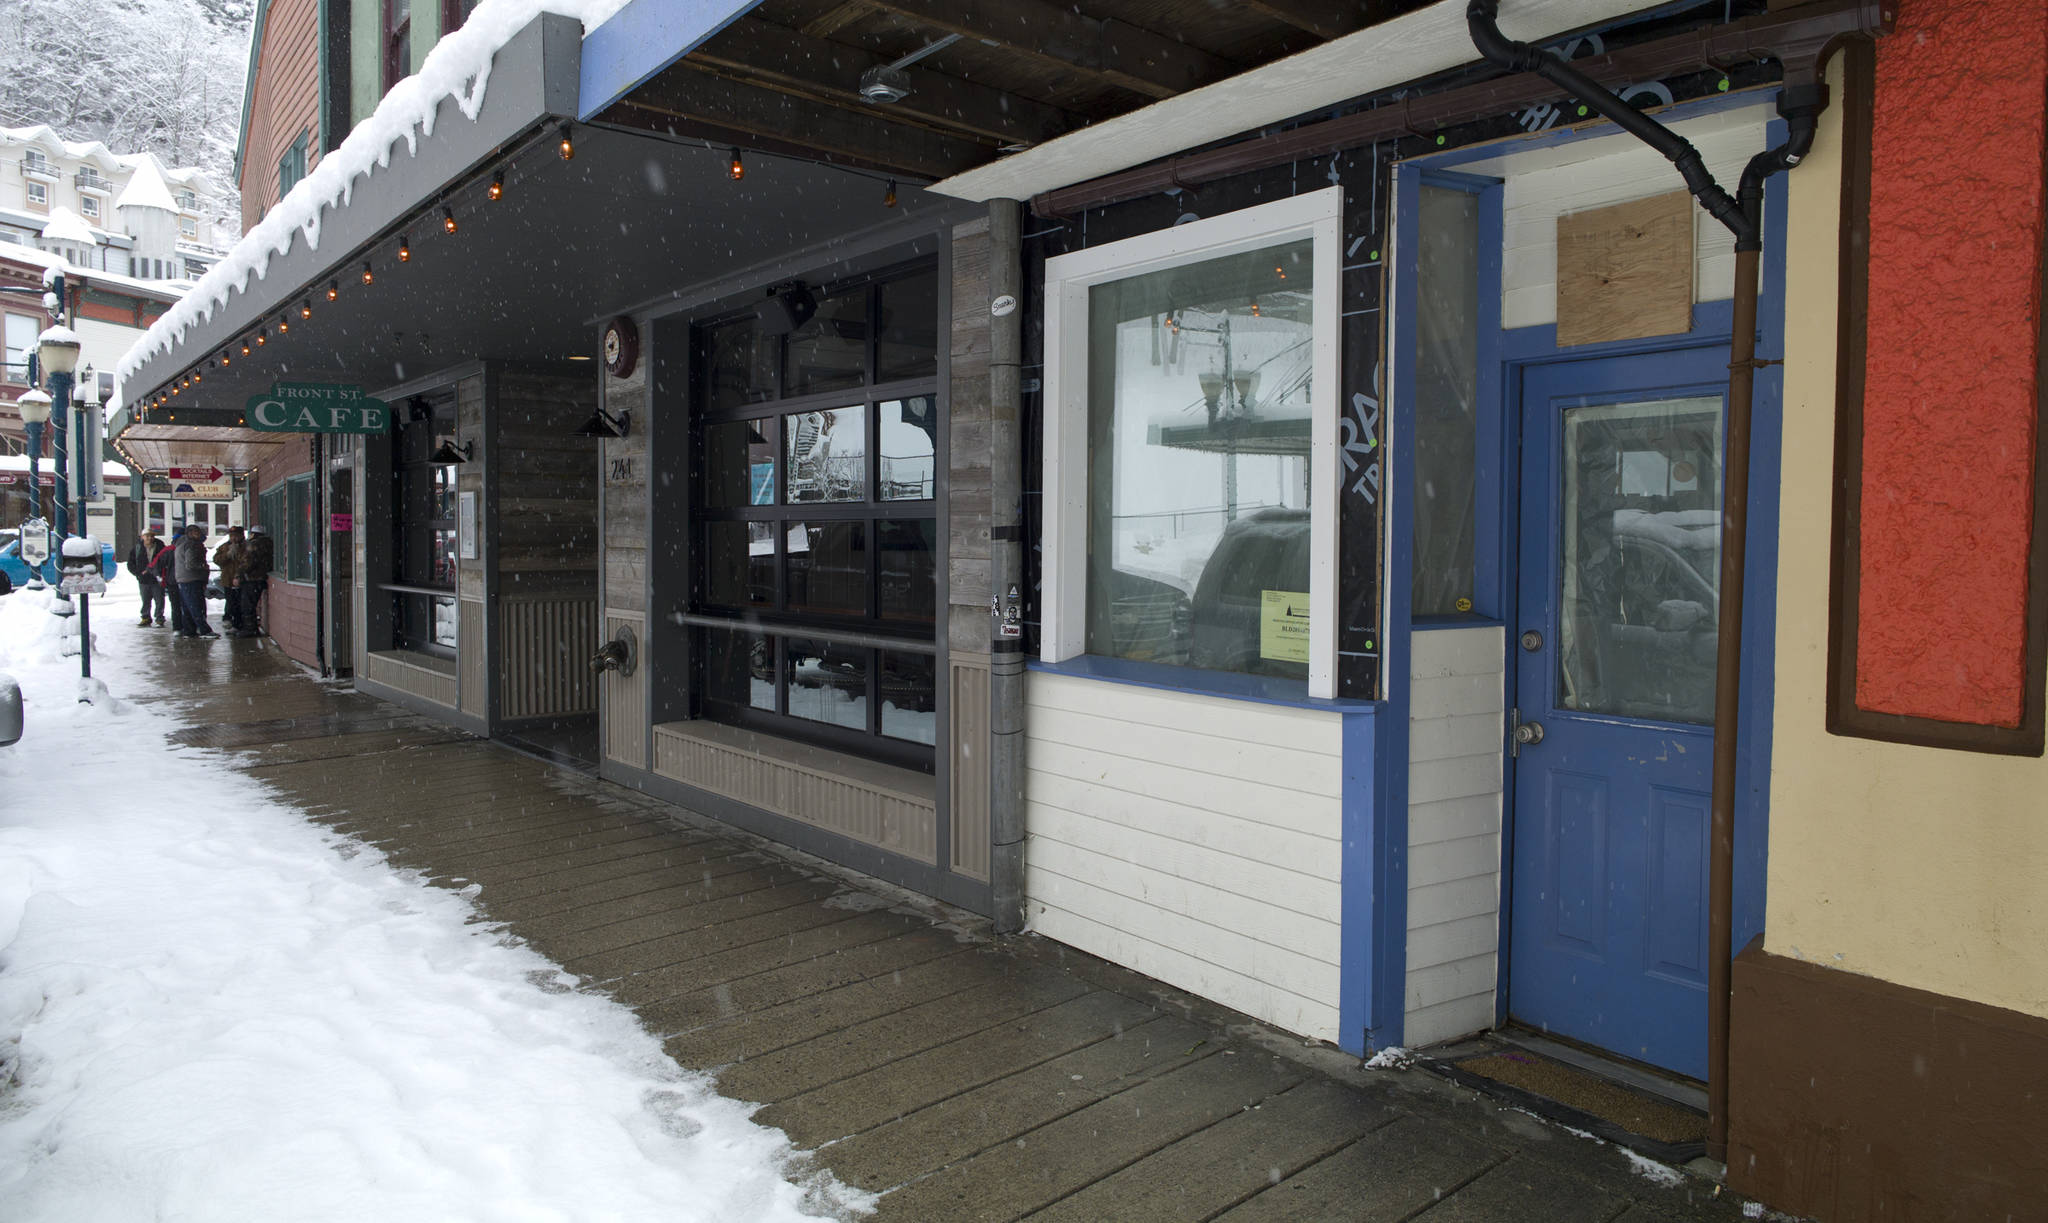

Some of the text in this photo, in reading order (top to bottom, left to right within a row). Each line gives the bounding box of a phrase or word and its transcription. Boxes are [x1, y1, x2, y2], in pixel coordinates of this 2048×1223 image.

[277, 387, 362, 401] FRONT ST.
[254, 400, 384, 429] CAFE
[611, 458, 633, 481] 241
